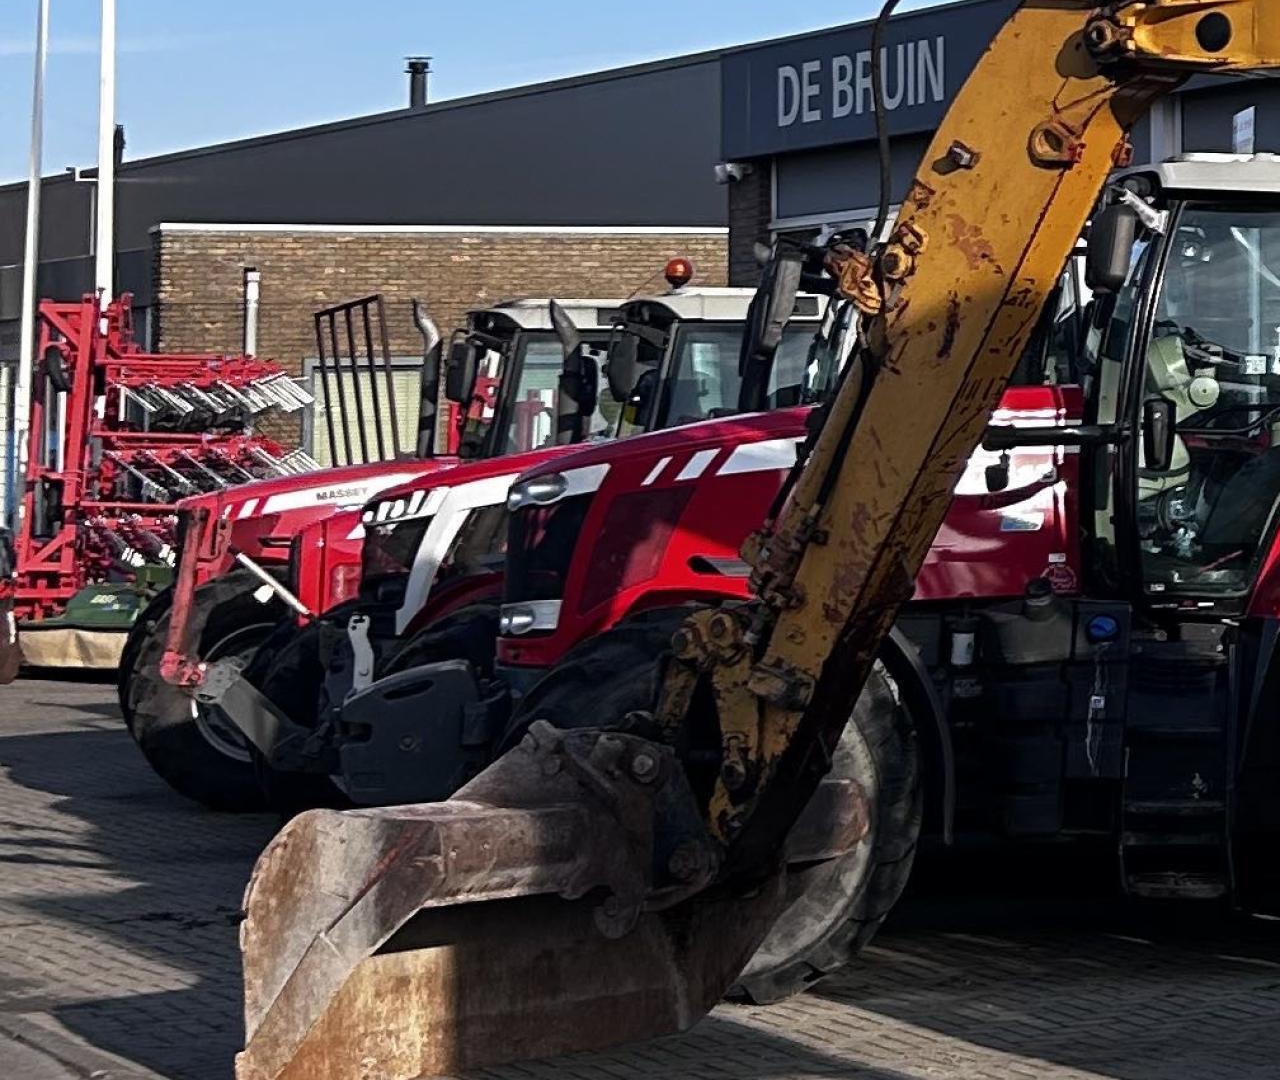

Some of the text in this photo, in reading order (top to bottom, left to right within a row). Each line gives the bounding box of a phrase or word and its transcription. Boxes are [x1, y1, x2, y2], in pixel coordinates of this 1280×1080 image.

[777, 36, 945, 127] DE BRUIN
[316, 488, 367, 500] MASSEY
